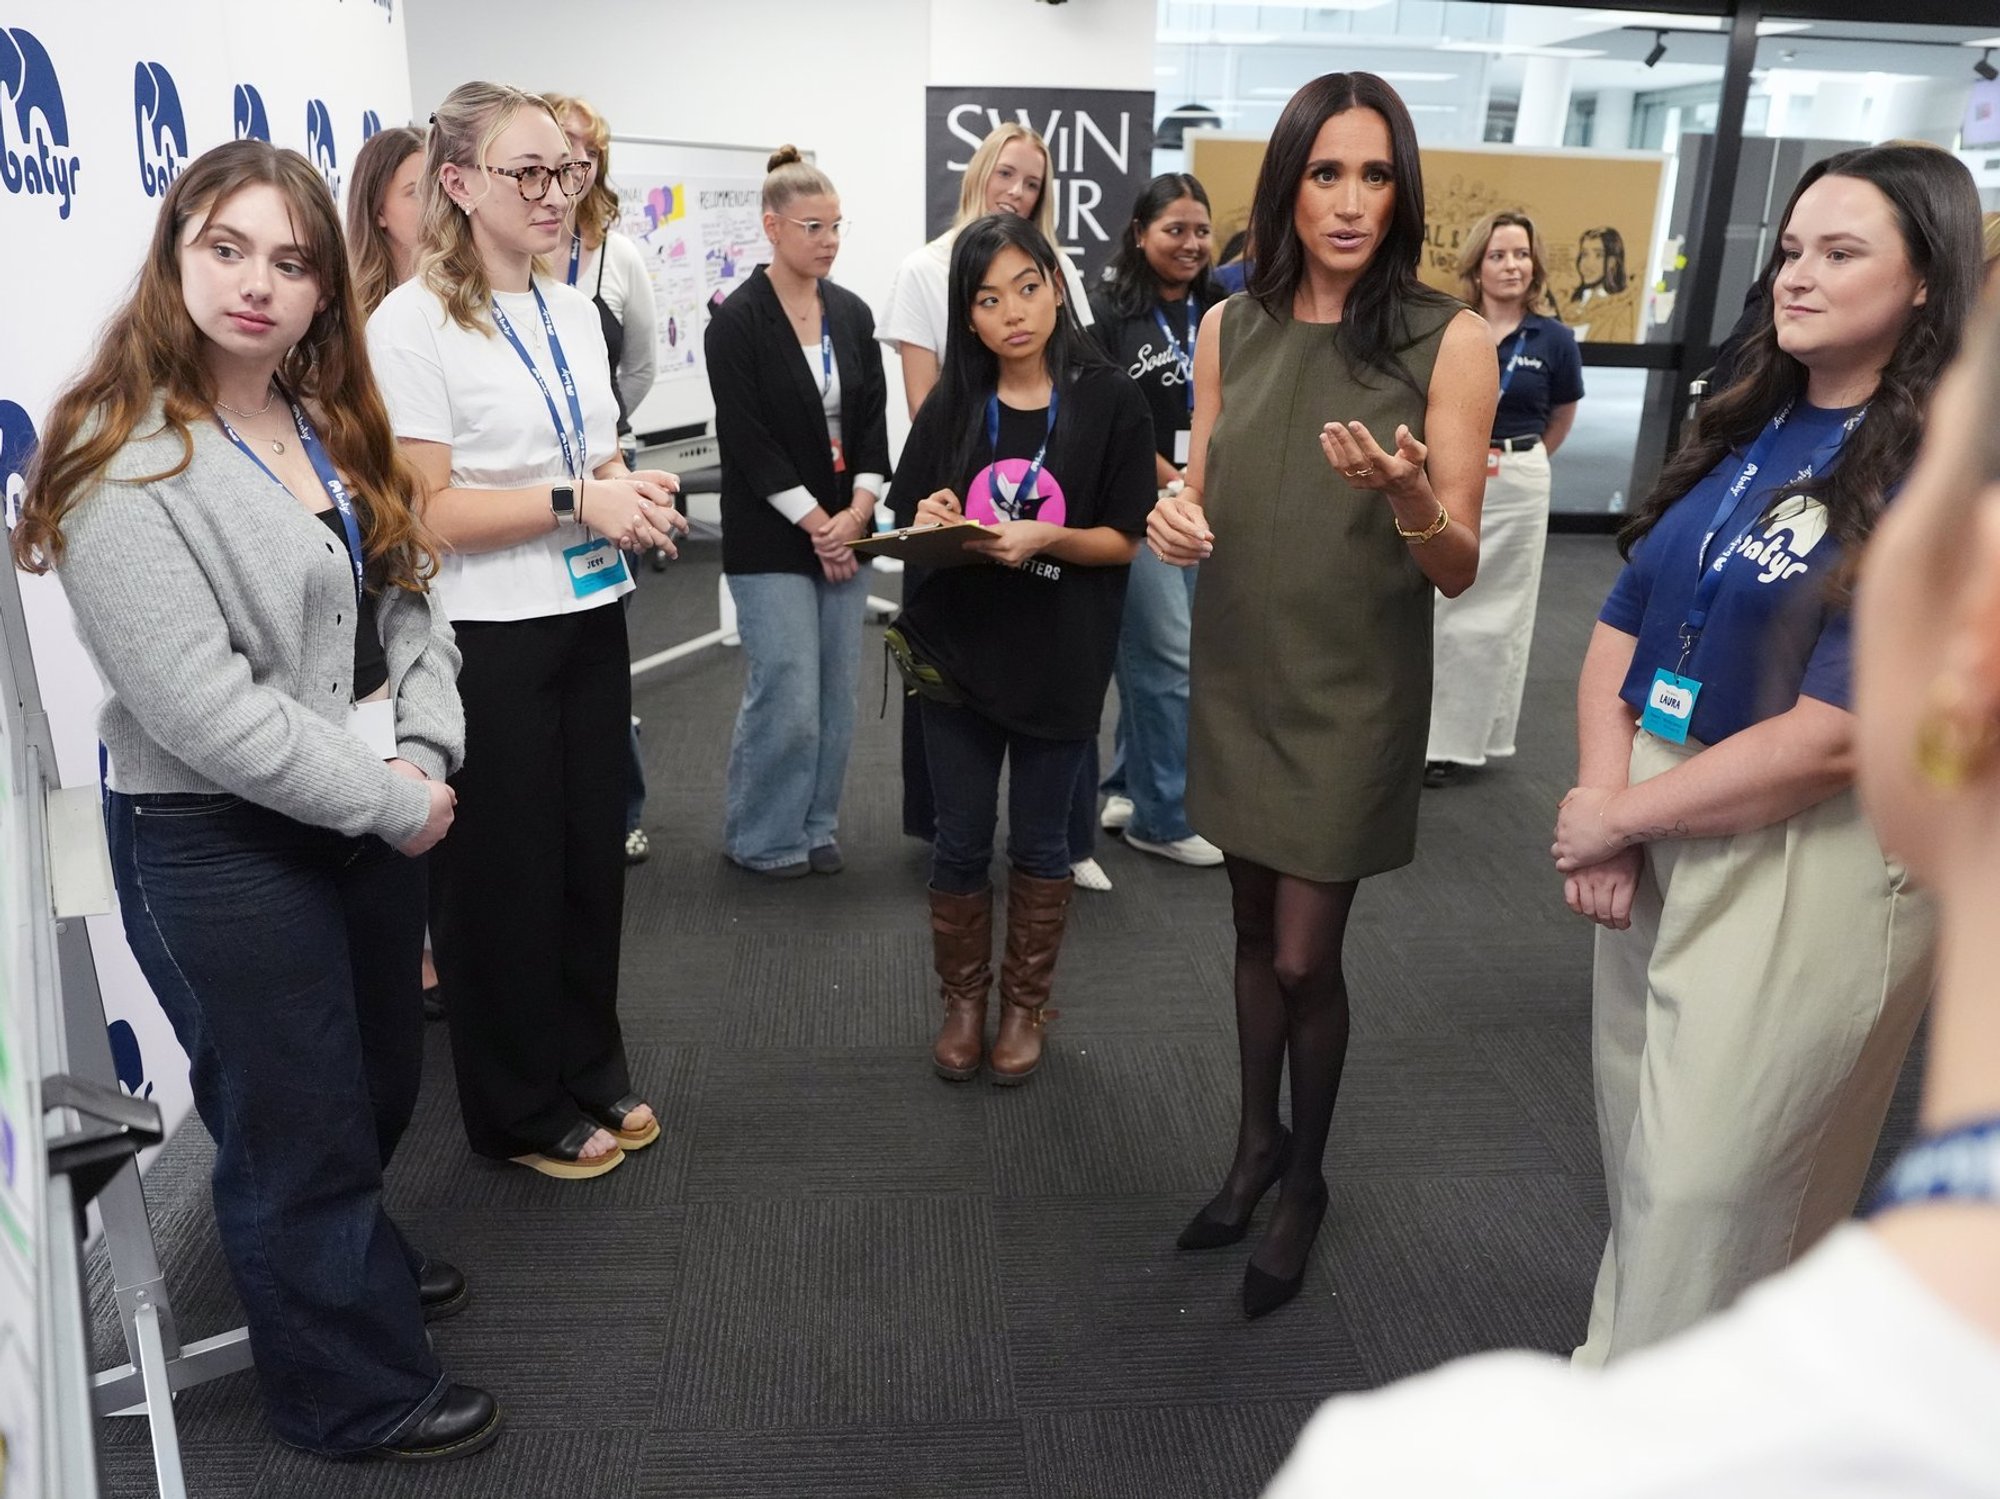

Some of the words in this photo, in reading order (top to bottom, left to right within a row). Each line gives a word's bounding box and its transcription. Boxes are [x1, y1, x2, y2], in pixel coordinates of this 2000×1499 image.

[0, 127, 80, 220] batyr
[297, 414, 311, 441] batyr
[336, 492, 350, 516] batyr
[1660, 694, 1680, 710] LAURA
